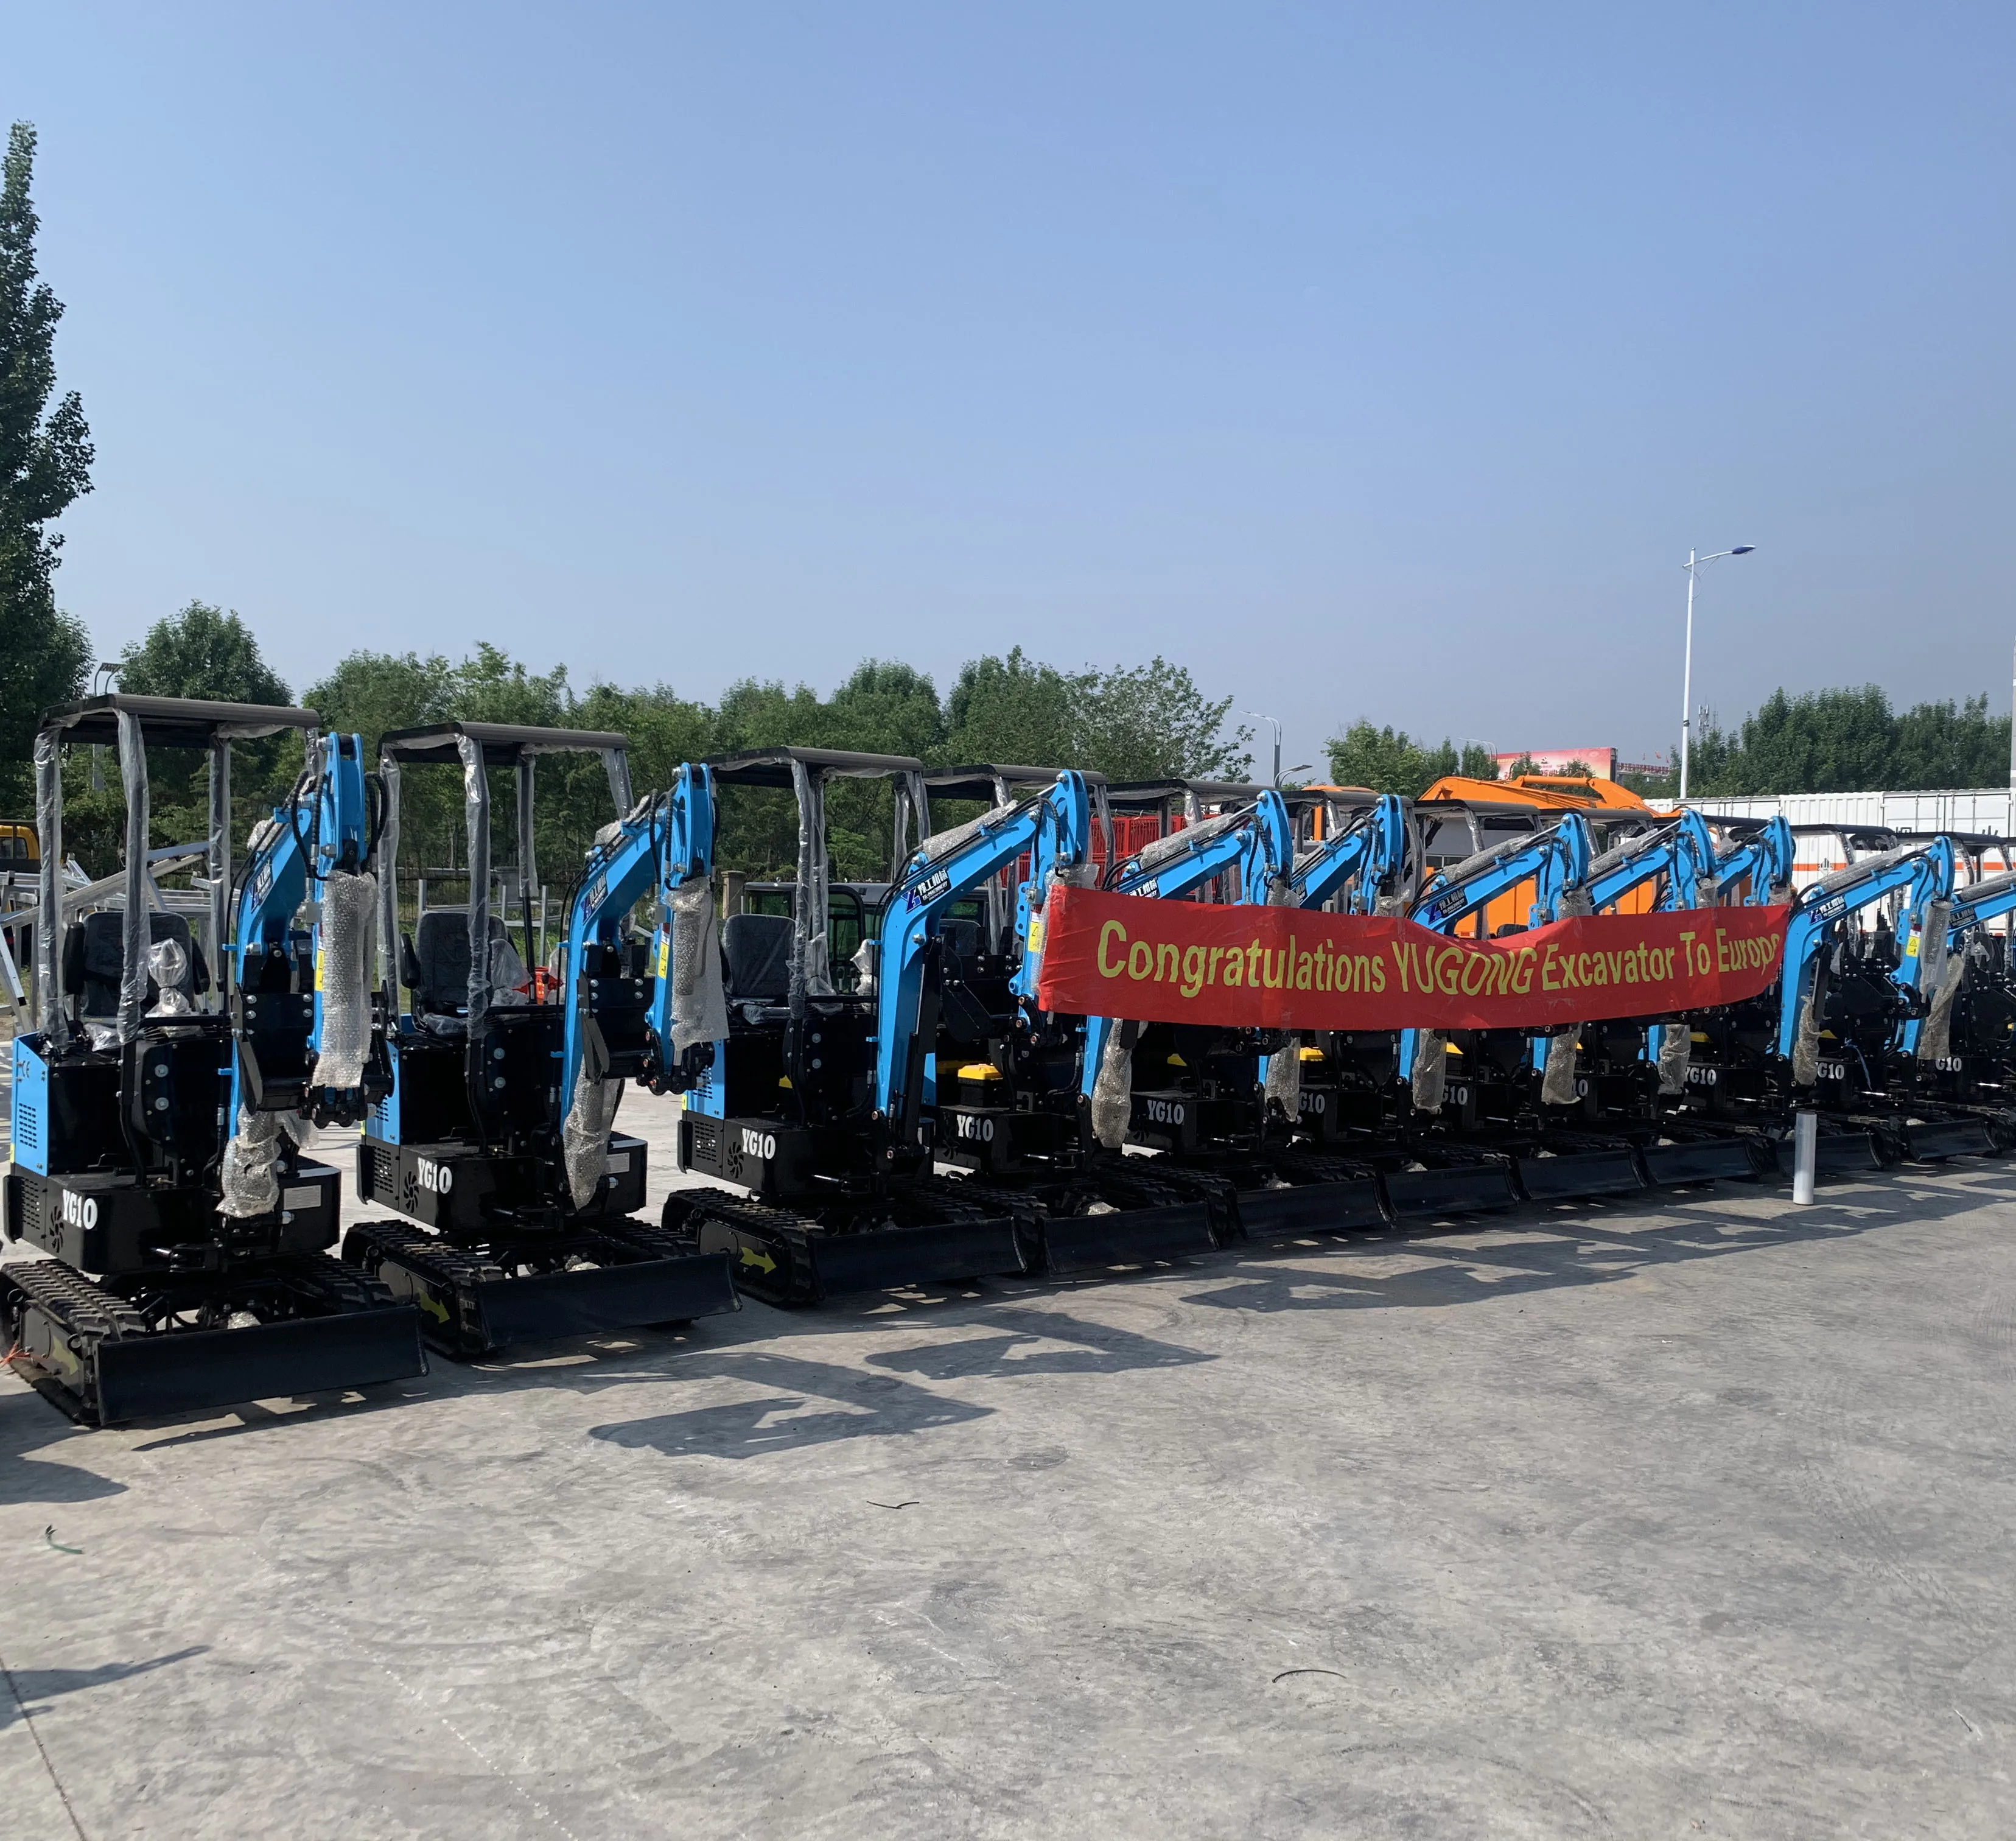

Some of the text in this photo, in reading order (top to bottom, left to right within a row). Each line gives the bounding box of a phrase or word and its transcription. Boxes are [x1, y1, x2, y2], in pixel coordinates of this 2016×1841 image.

[1097, 920, 1386, 998] Congratulations
[1391, 941, 1538, 996] YUGONG
[1542, 942, 1675, 991] Excavator
[1679, 931, 1710, 977] To
[1815, 1062, 1844, 1079] G10
[1936, 1057, 1962, 1071] G10
[1298, 1092, 1325, 1113] G10
[1443, 1085, 1468, 1105] G10
[1147, 1099, 1184, 1125] YG10
[957, 1115, 993, 1141] YG10
[742, 1127, 775, 1160] YG10
[418, 1157, 452, 1194] YG10
[63, 1188, 97, 1230] YG10
